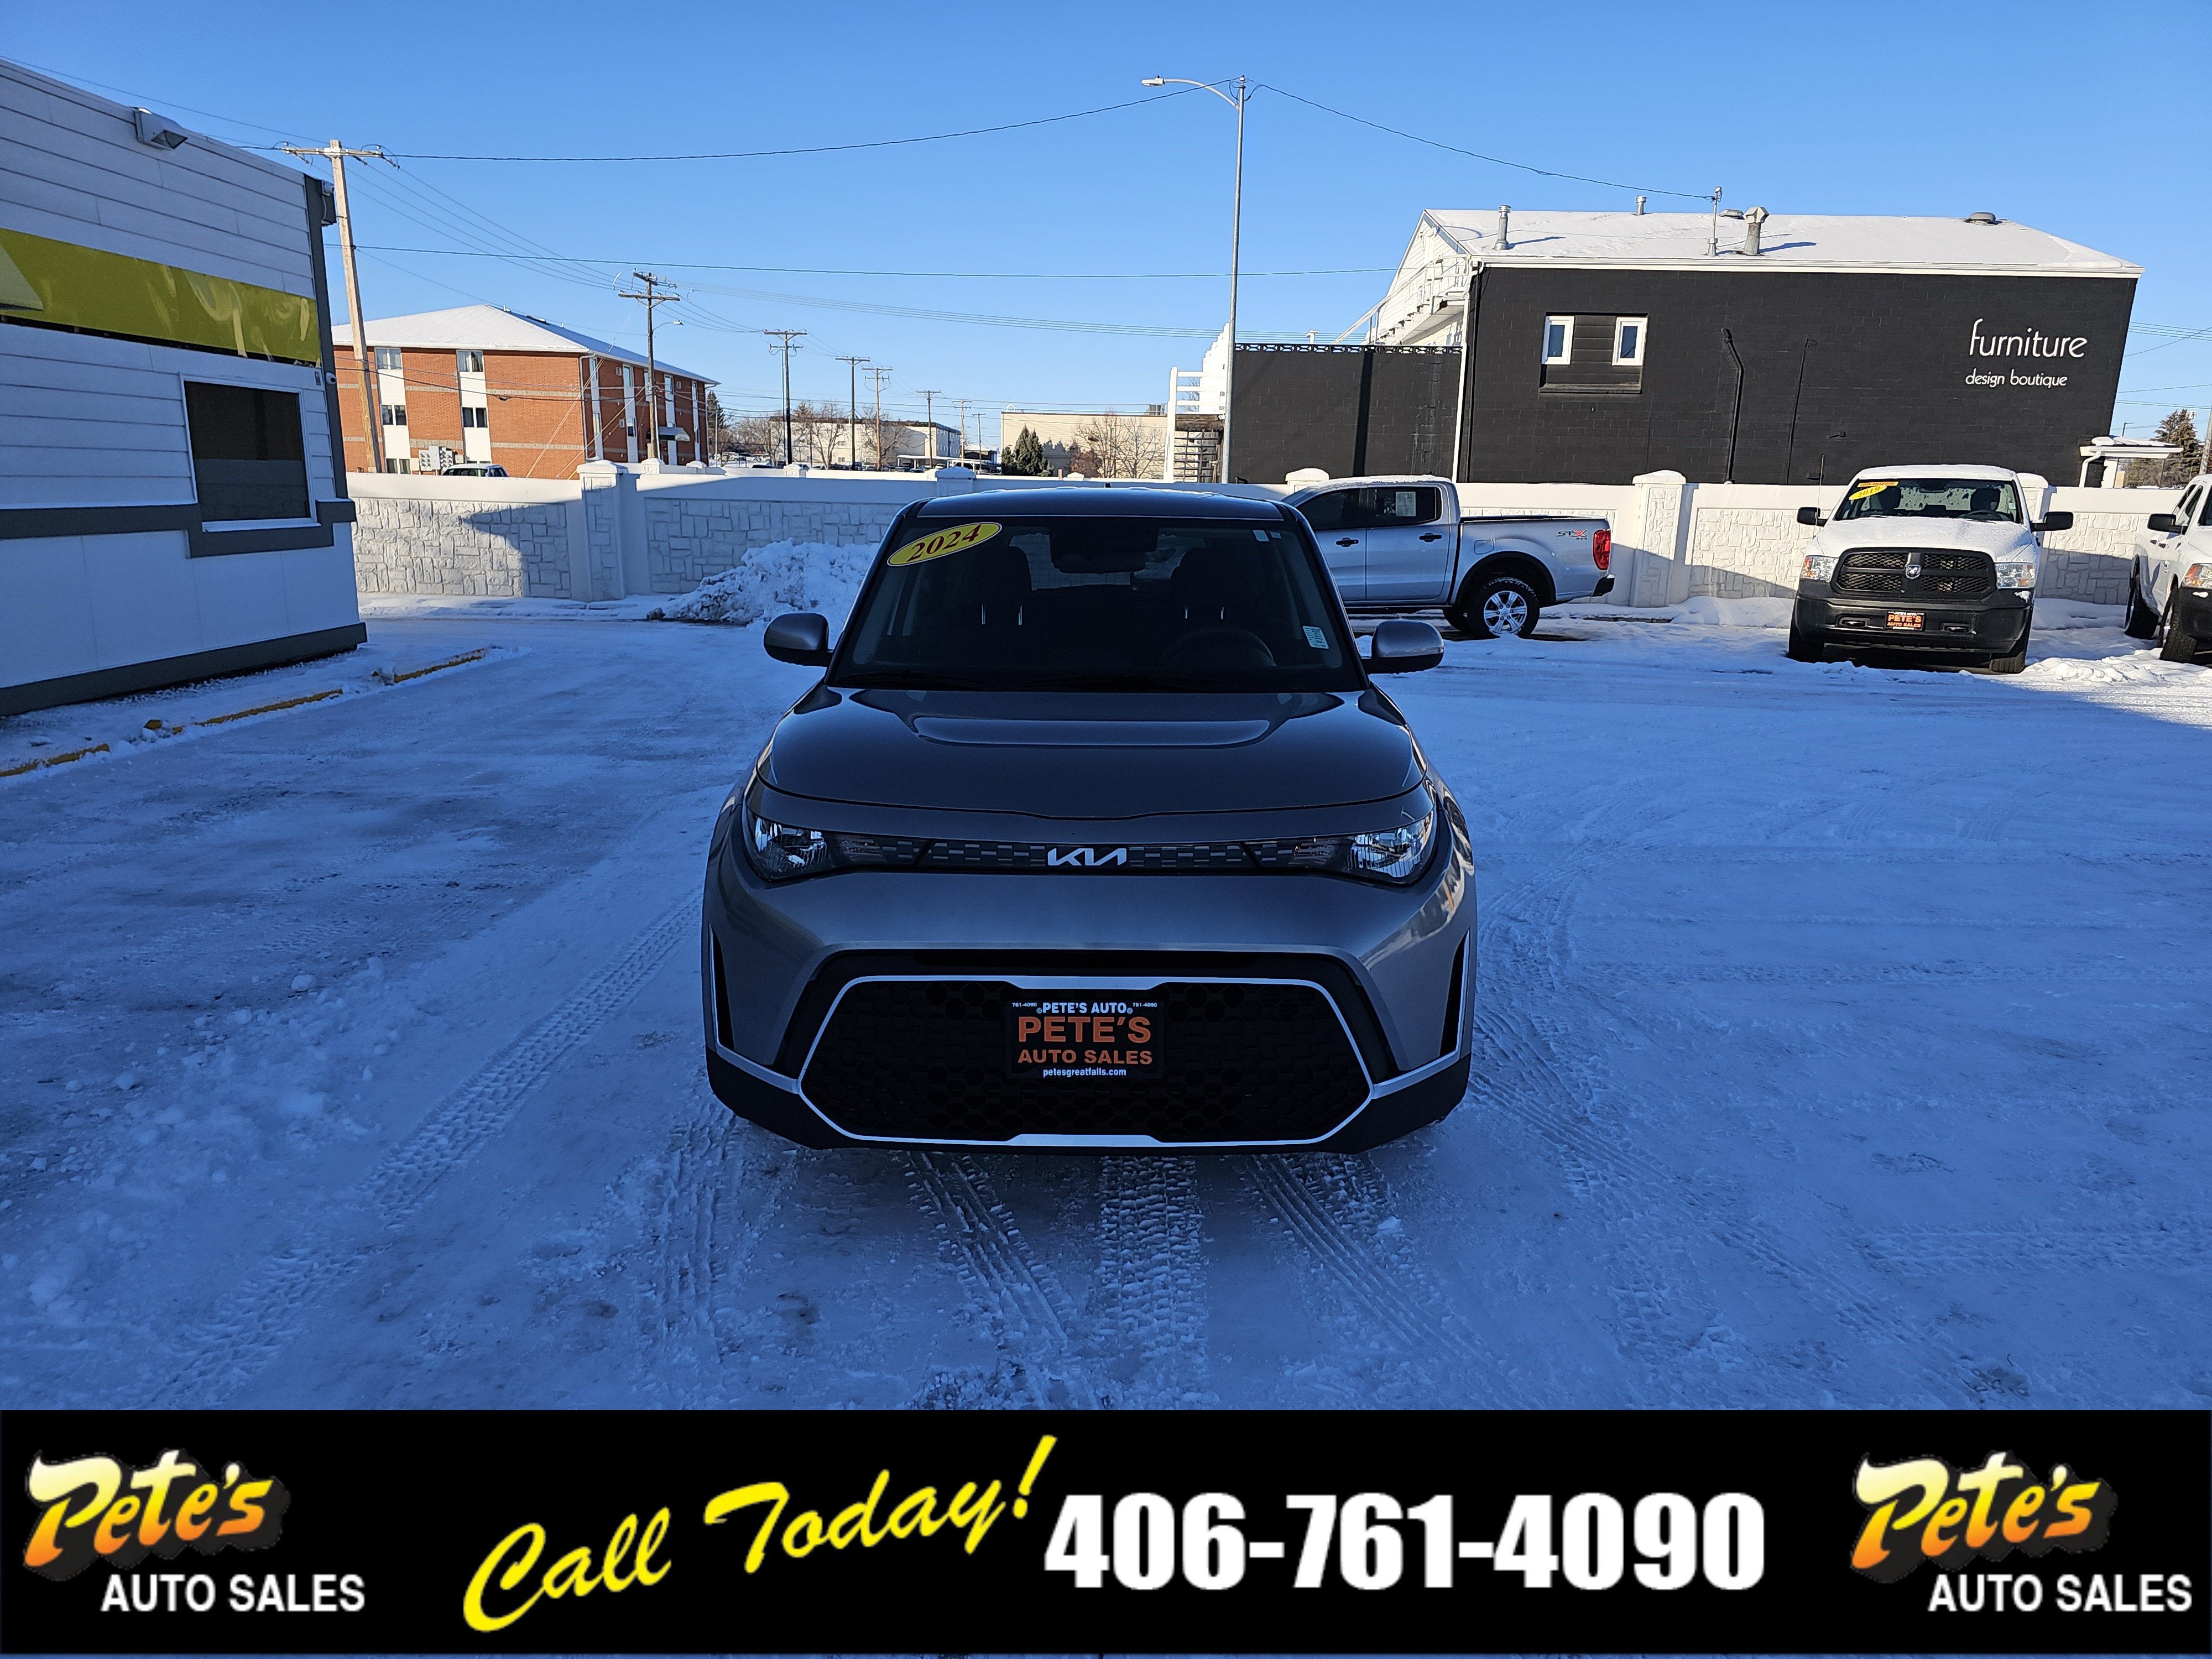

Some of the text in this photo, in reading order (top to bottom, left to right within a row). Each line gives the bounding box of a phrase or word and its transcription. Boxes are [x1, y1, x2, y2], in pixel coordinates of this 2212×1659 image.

[1969, 318, 2088, 358] furniture
[1965, 368, 2068, 388] design boutique
[1858, 487, 1880, 498] 2019
[1556, 529, 1588, 537] STX
[906, 524, 982, 562] 2024
[1887, 614, 1922, 623] PETE'S
[1047, 848, 1127, 866] KIA
[1042, 1002, 1127, 1014] PETE'S AUTO
[1018, 1016, 1151, 1044] PETE'S
[1018, 1050, 1152, 1065] AUTO SALES
[1043, 1068, 1126, 1078] petesgreatfalls.com
